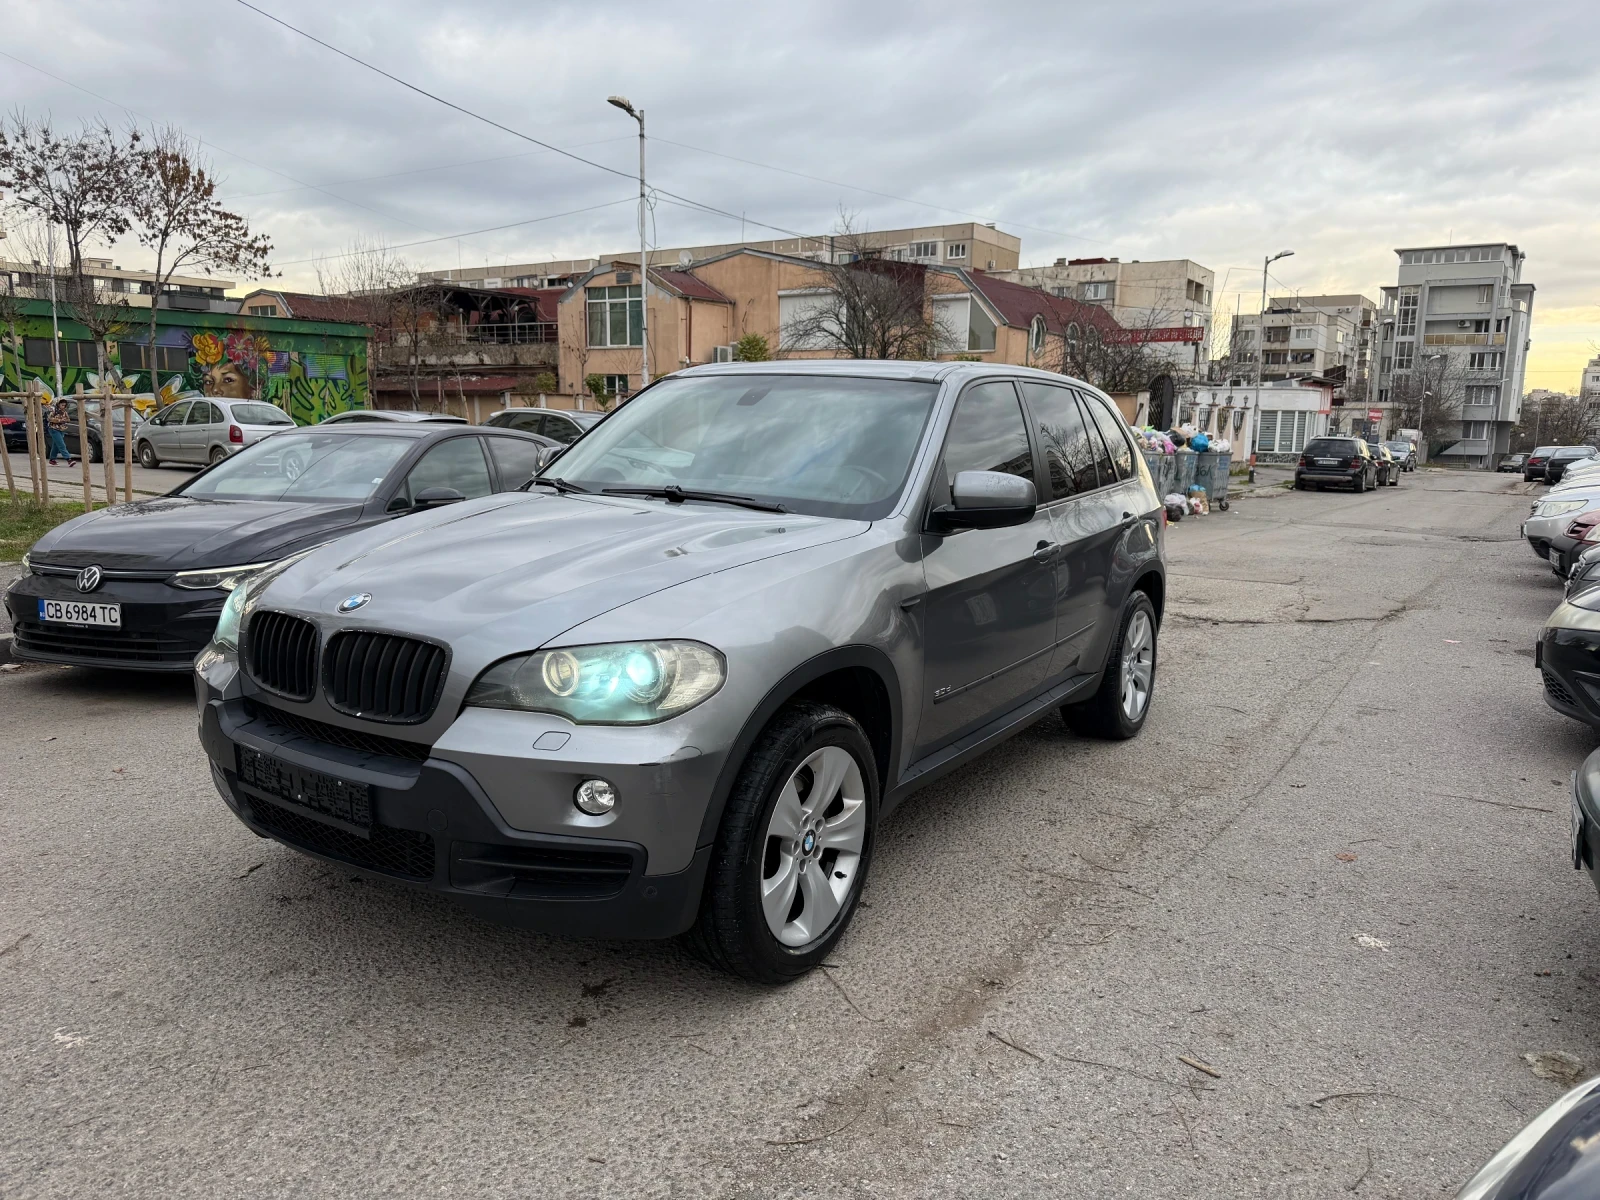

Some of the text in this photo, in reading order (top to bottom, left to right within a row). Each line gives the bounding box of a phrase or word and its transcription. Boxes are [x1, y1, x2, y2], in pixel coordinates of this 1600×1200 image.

[46, 603, 118, 623] CB 6984 TC
